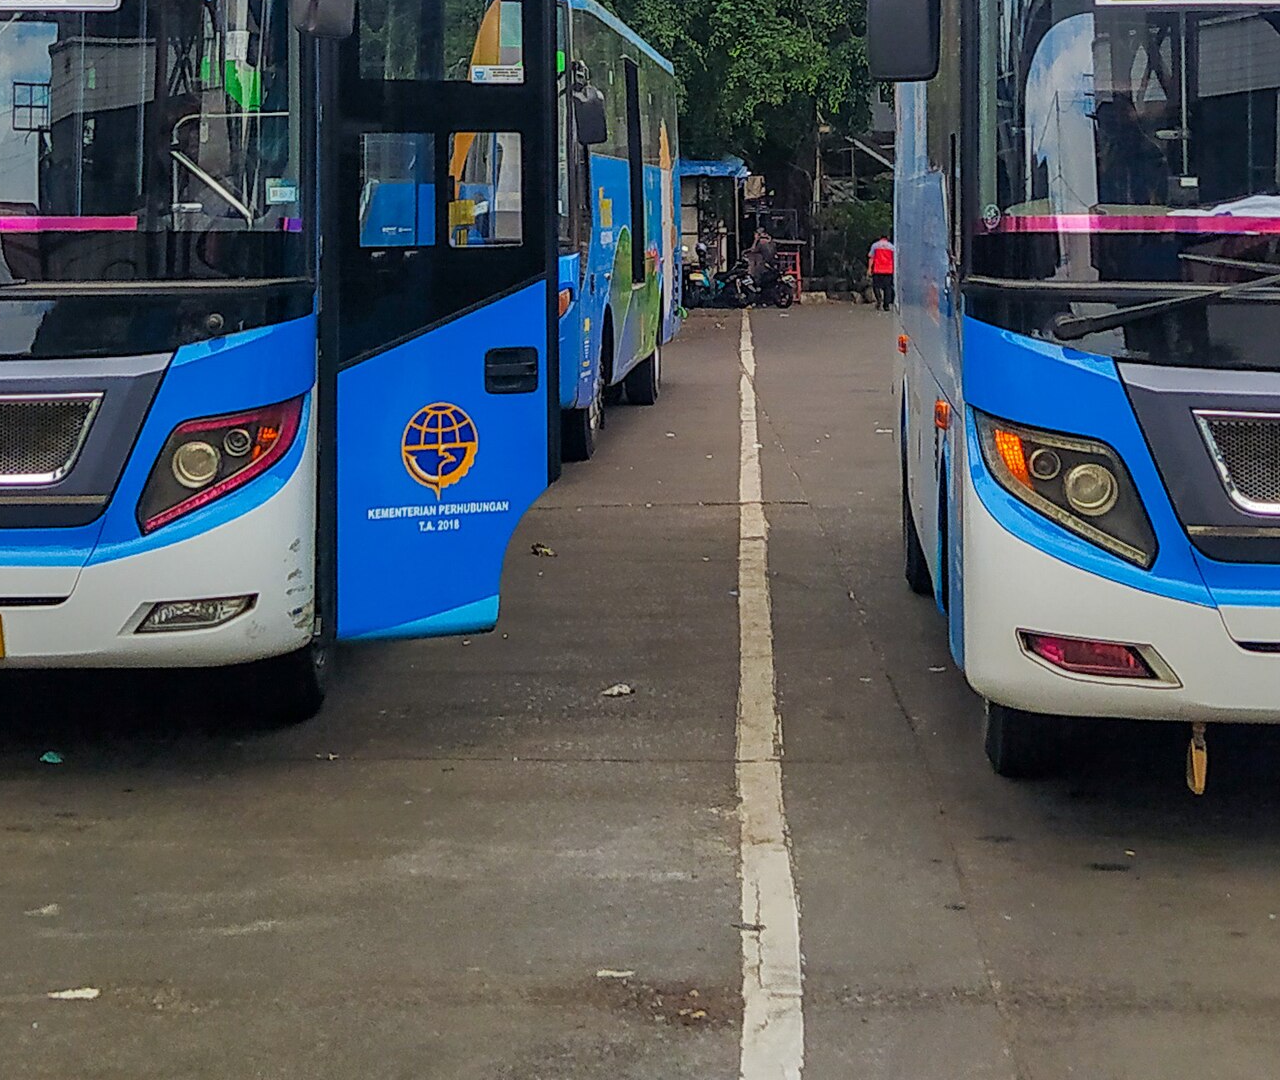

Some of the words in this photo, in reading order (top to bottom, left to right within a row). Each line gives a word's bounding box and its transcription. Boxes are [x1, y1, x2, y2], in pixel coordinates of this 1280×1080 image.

[367, 505, 437, 520] KEMENTERIAN
[438, 501, 510, 515] PERHUBUNGAN
[418, 520, 436, 532] T.A.
[437, 519, 460, 531] 2018
